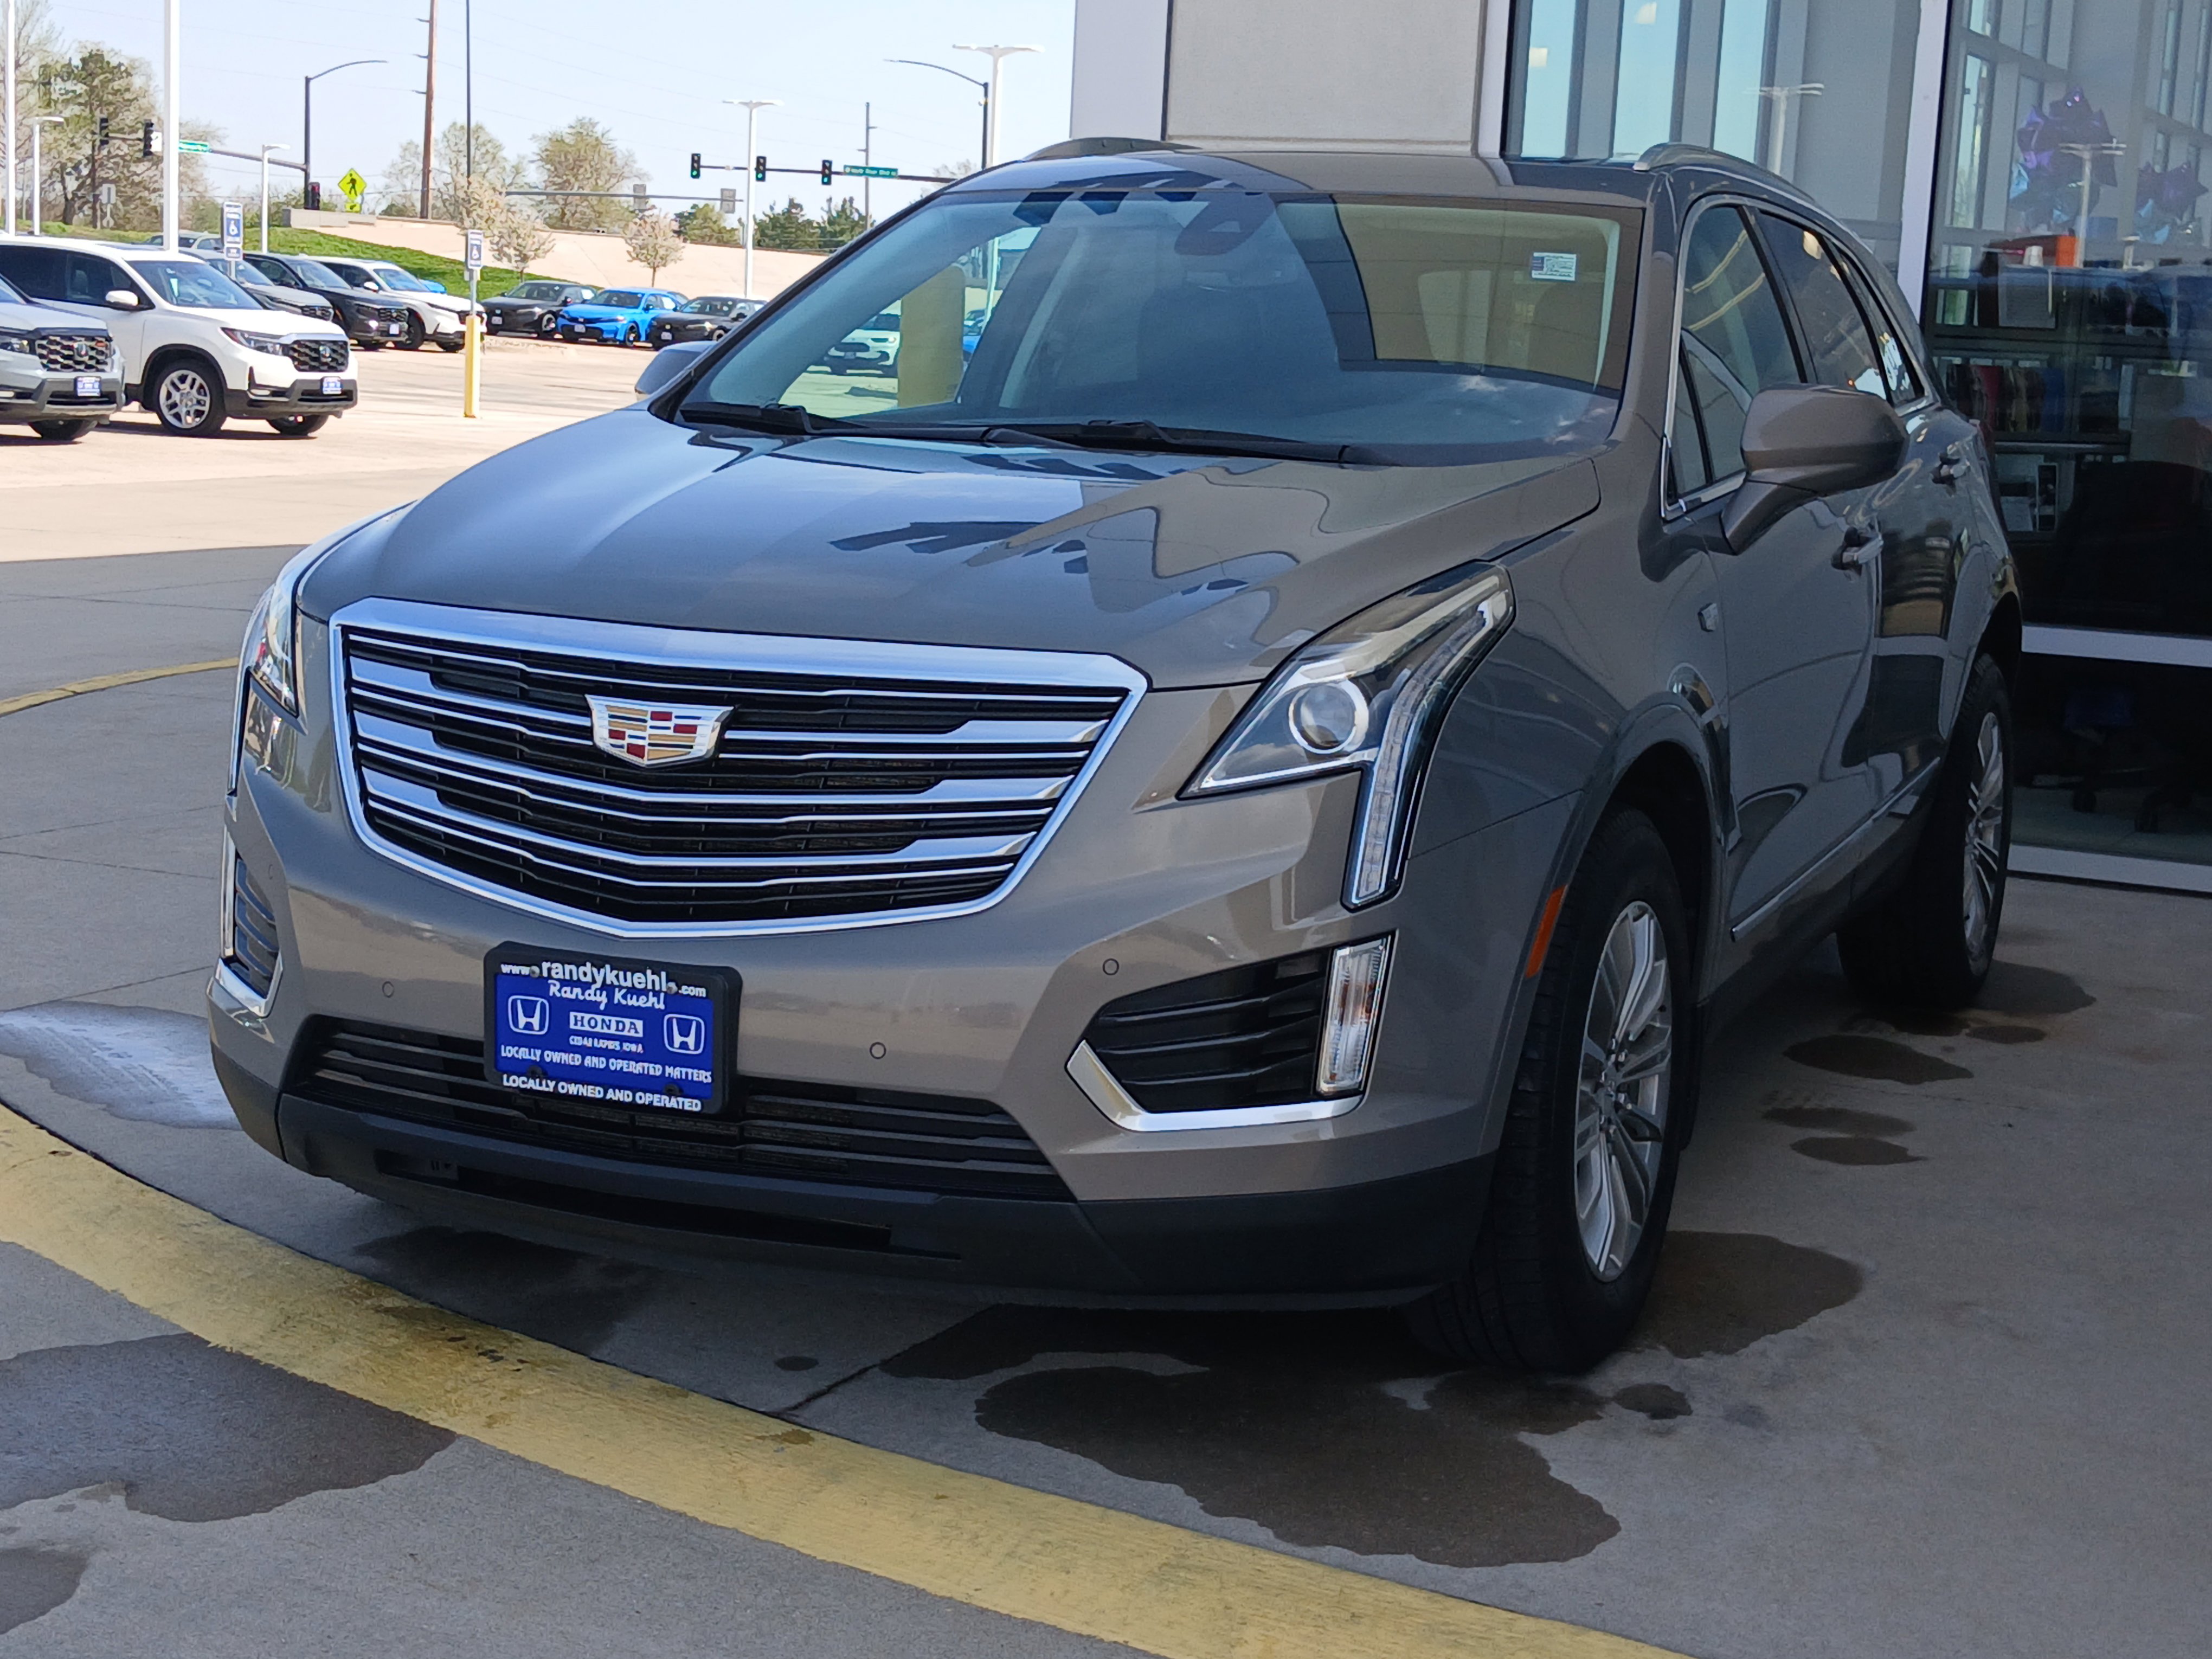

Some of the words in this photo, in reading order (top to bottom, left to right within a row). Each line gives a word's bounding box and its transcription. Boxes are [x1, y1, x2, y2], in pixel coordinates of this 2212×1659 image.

[548, 980, 608, 1010] Randy
[614, 988, 665, 1009] Kuehl
[573, 1015, 640, 1034] HONDA
[501, 1045, 541, 1062] LOCALLY
[544, 1051, 582, 1065] OWNED
[584, 1056, 607, 1069] AND
[609, 1058, 663, 1076] OPERATED
[665, 1066, 712, 1083] MATTERS
[503, 1074, 556, 1092] LOCALLY
[558, 1082, 604, 1098] OWNED
[606, 1089, 633, 1103] AND
[635, 1092, 702, 1111] OPERATED
